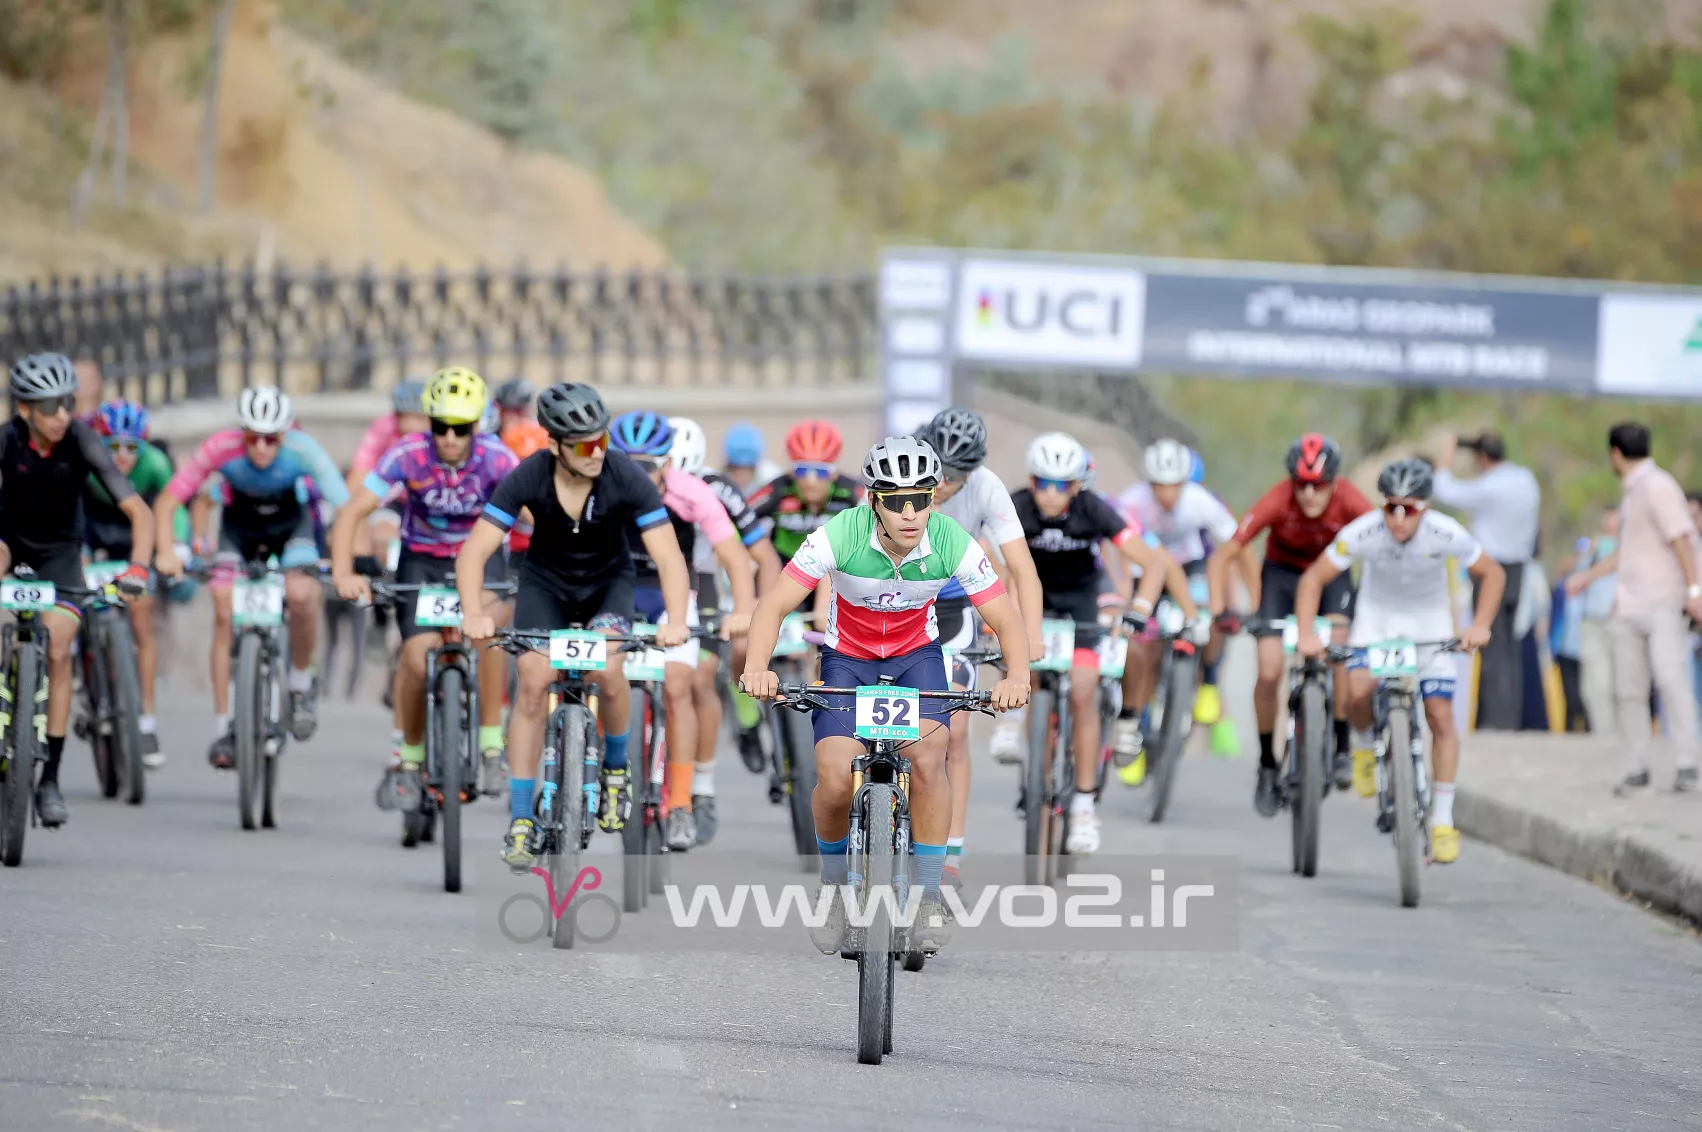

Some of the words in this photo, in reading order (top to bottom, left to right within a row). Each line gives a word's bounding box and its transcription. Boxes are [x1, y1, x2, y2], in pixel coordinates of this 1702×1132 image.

[1003, 288, 1124, 338] UCI
[566, 639, 598, 659] 57
[872, 698, 911, 726] 52
[869, 728, 889, 736] MTB
